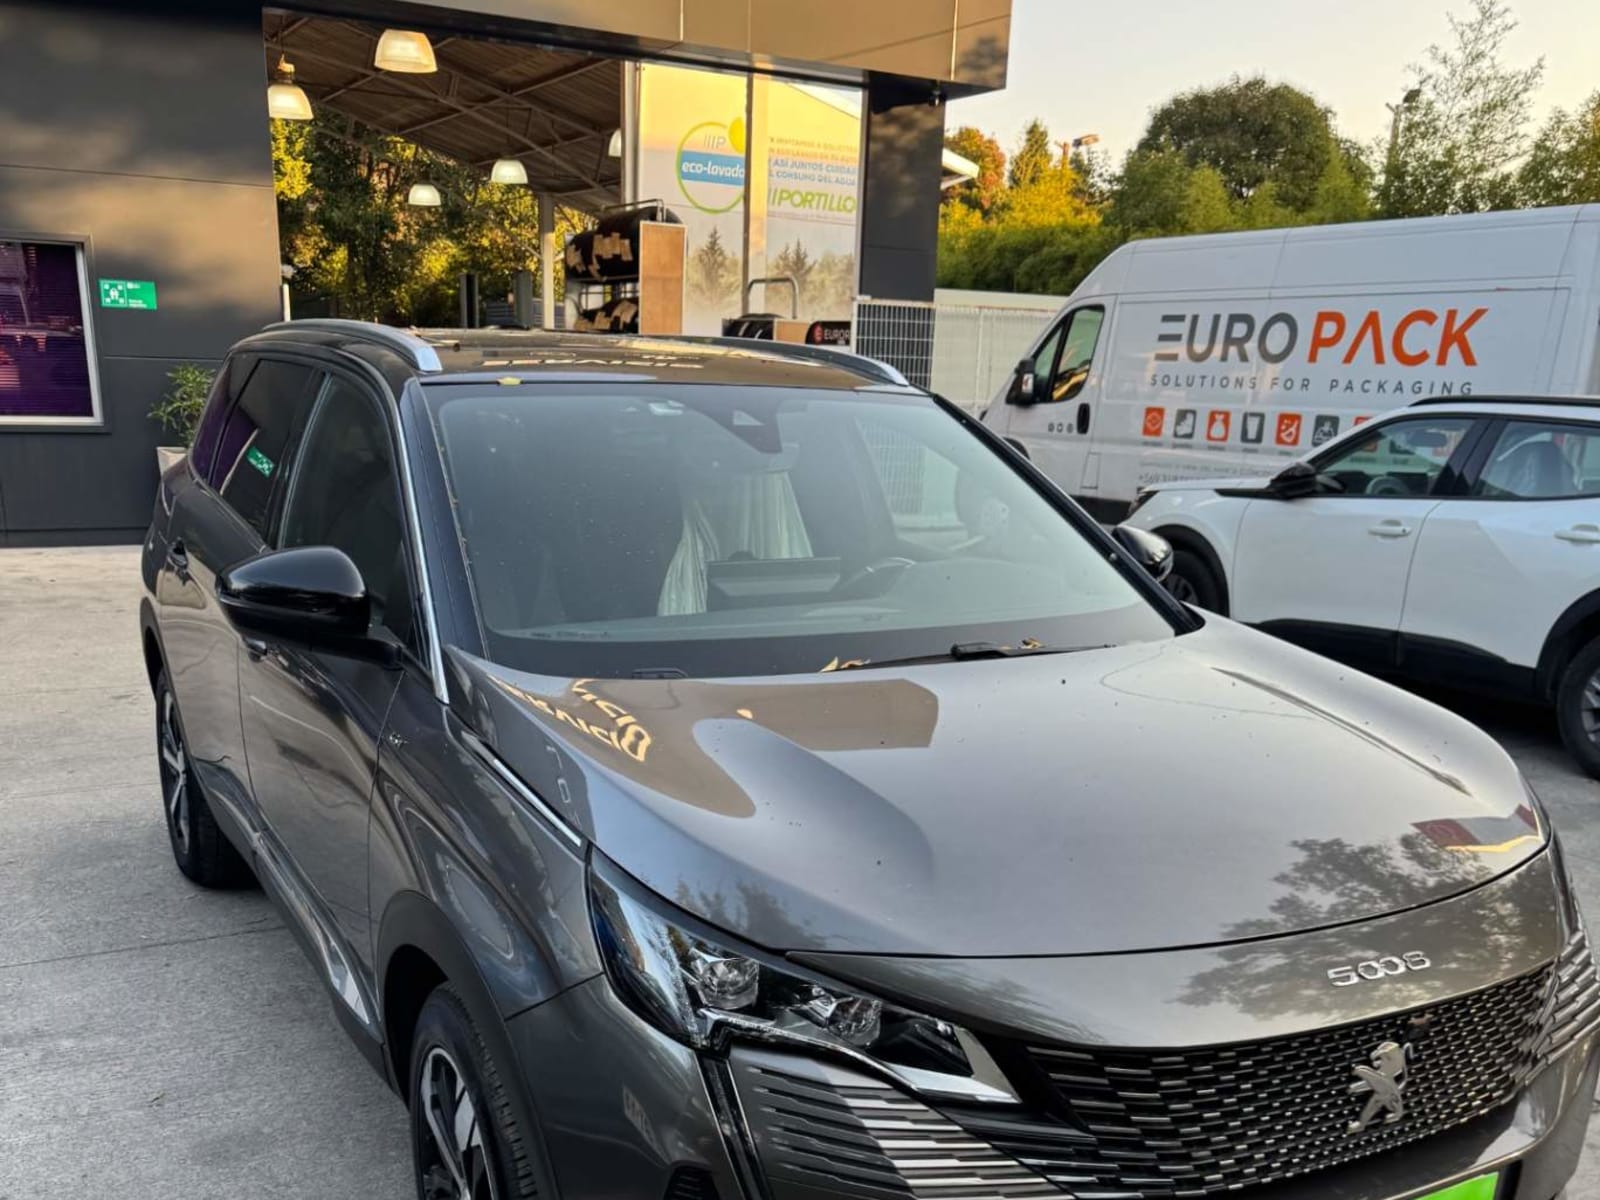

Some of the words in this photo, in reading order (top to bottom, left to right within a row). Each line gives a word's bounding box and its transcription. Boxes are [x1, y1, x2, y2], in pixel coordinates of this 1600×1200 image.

[1154, 311, 1299, 365] EURO
[1307, 307, 1490, 368] PACK
[1150, 373, 1257, 390] SOLUTIONS
[1269, 376, 1311, 392] FOR
[1328, 378, 1473, 396] PACKAGING
[1326, 950, 1432, 987] 5008
